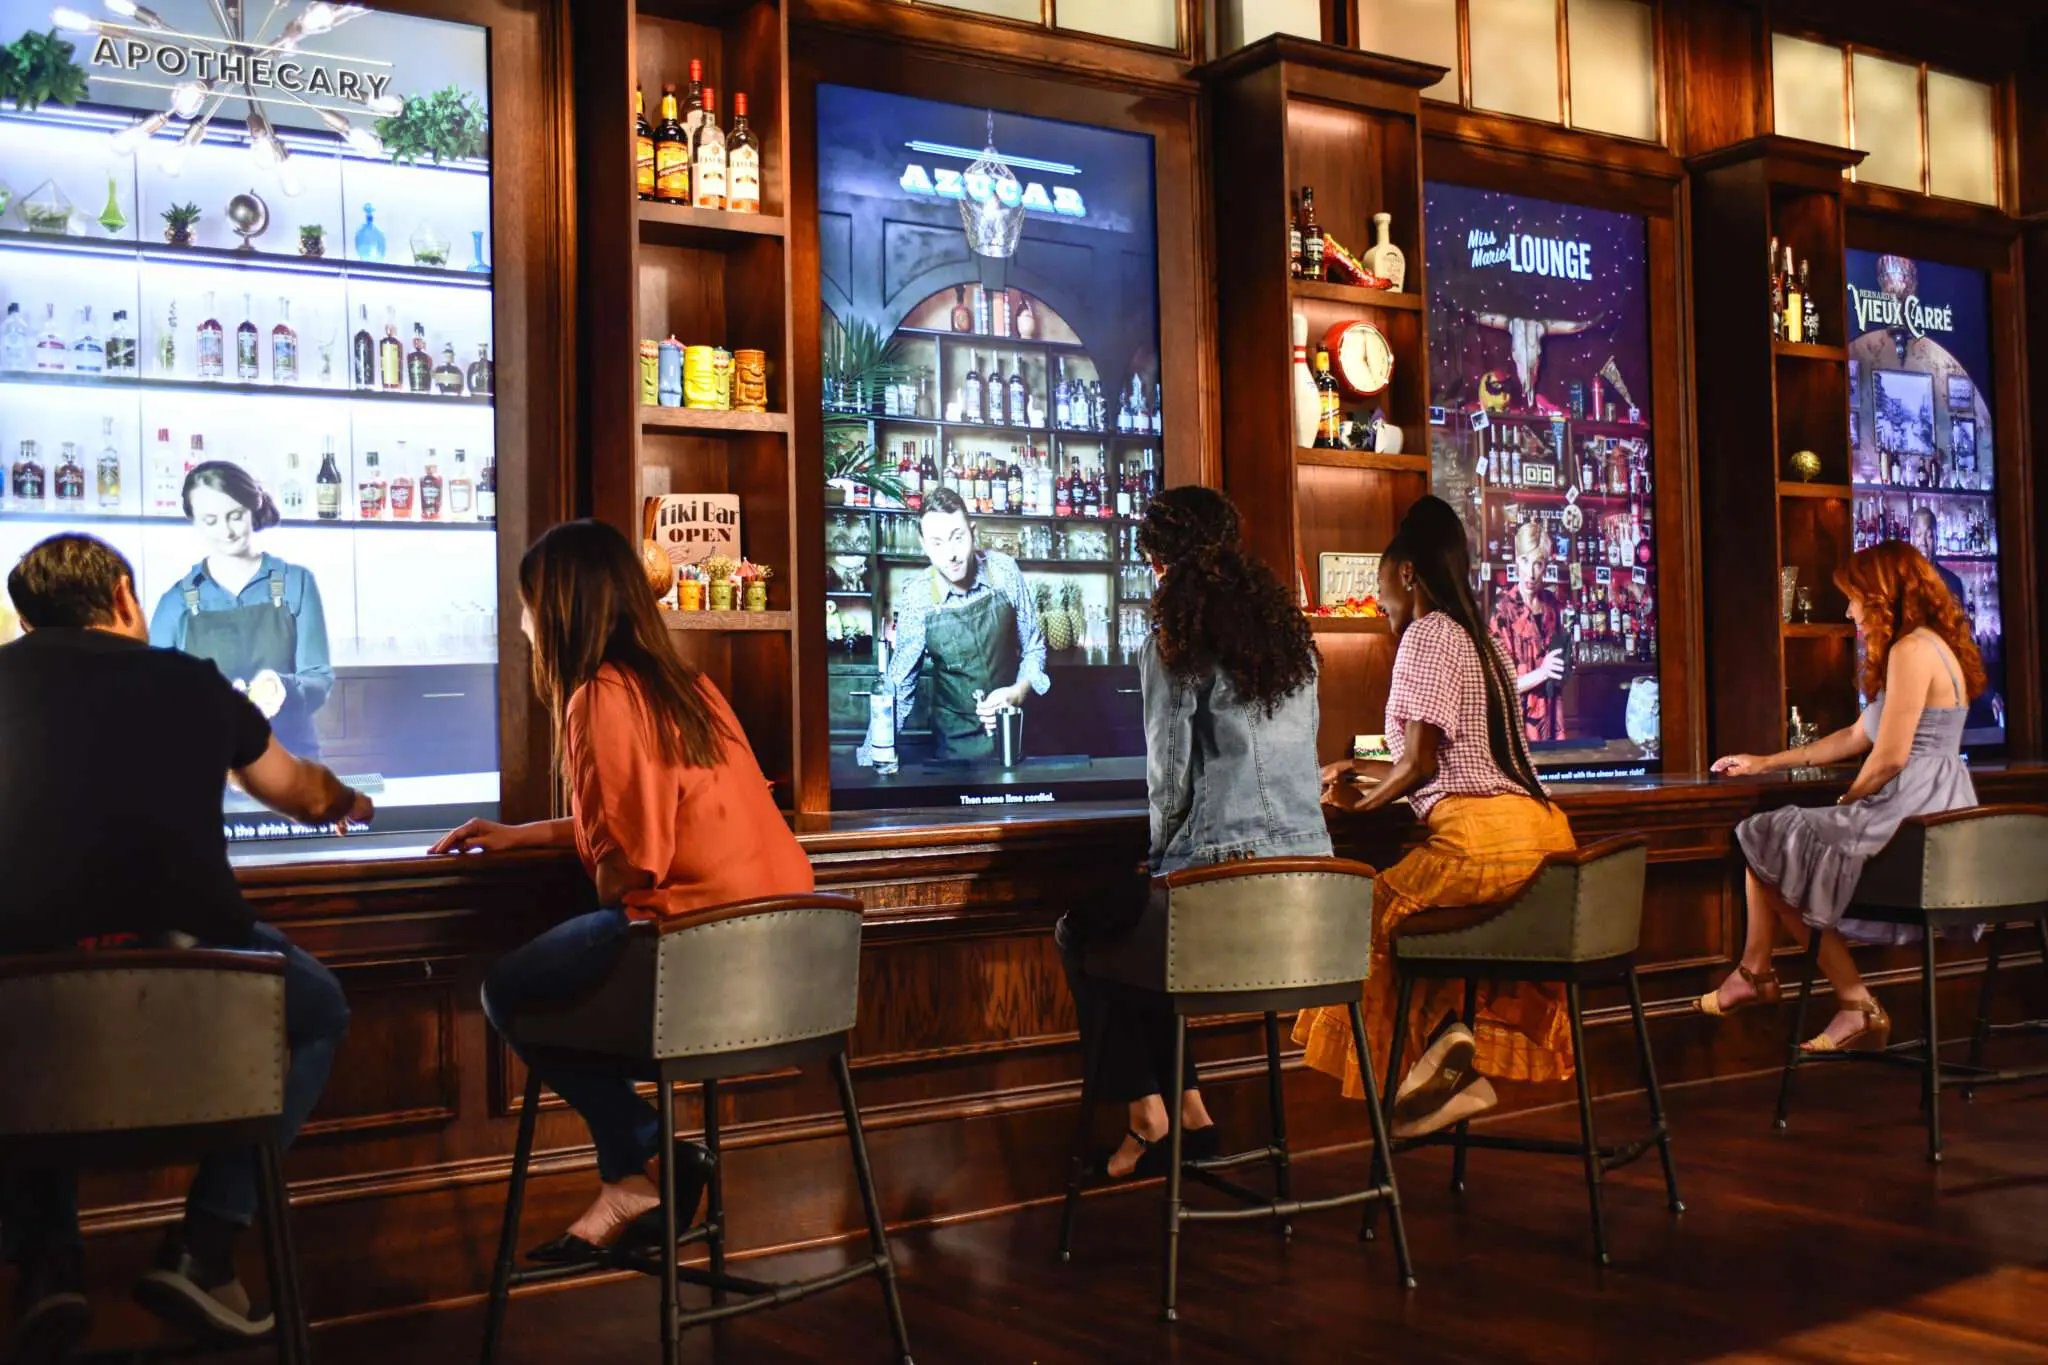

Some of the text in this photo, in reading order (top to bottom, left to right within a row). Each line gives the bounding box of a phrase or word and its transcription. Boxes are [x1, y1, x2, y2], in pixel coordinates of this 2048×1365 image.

[92, 36, 393, 101] APOTHECARY
[1468, 229, 1497, 249] Miss
[1471, 241, 1512, 268] Marie's
[1509, 233, 1593, 281] LOUNGE
[1847, 284, 1904, 331] VIEUX
[1904, 295, 1953, 339] CARRÉ
[660, 500, 740, 527] Tiki Bar
[668, 528, 732, 543] OPEN
[959, 792, 1055, 805] Then some lime cordial.
[233, 822, 256, 837] the
[257, 821, 289, 837] drink
